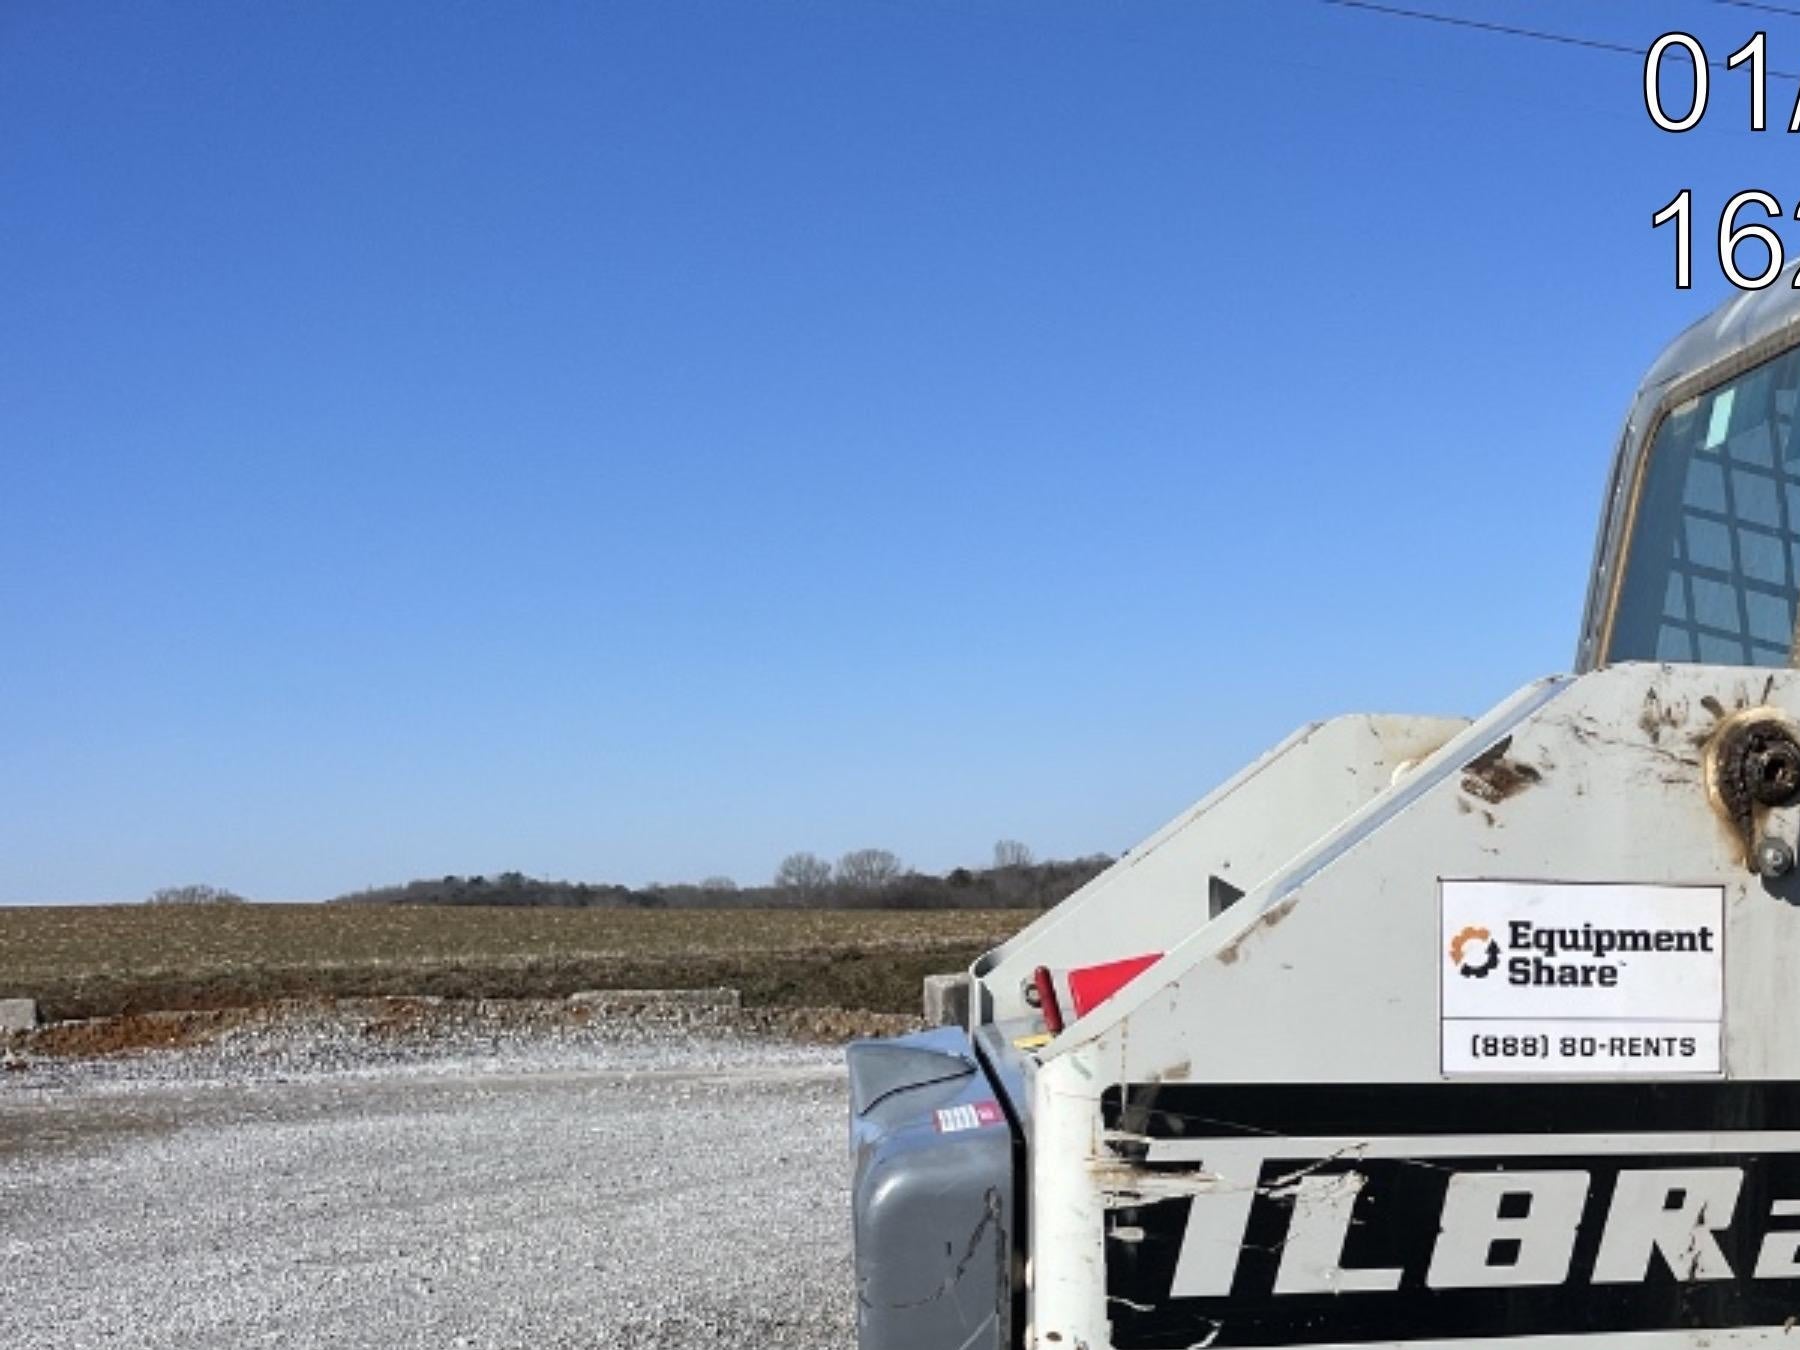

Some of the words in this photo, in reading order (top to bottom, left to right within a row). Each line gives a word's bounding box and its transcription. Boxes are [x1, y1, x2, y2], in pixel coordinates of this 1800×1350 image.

[1507, 920, 1715, 959] Equipment
[1507, 956, 1619, 988] Share
[1558, 1036, 1698, 1058] 80-RENTS
